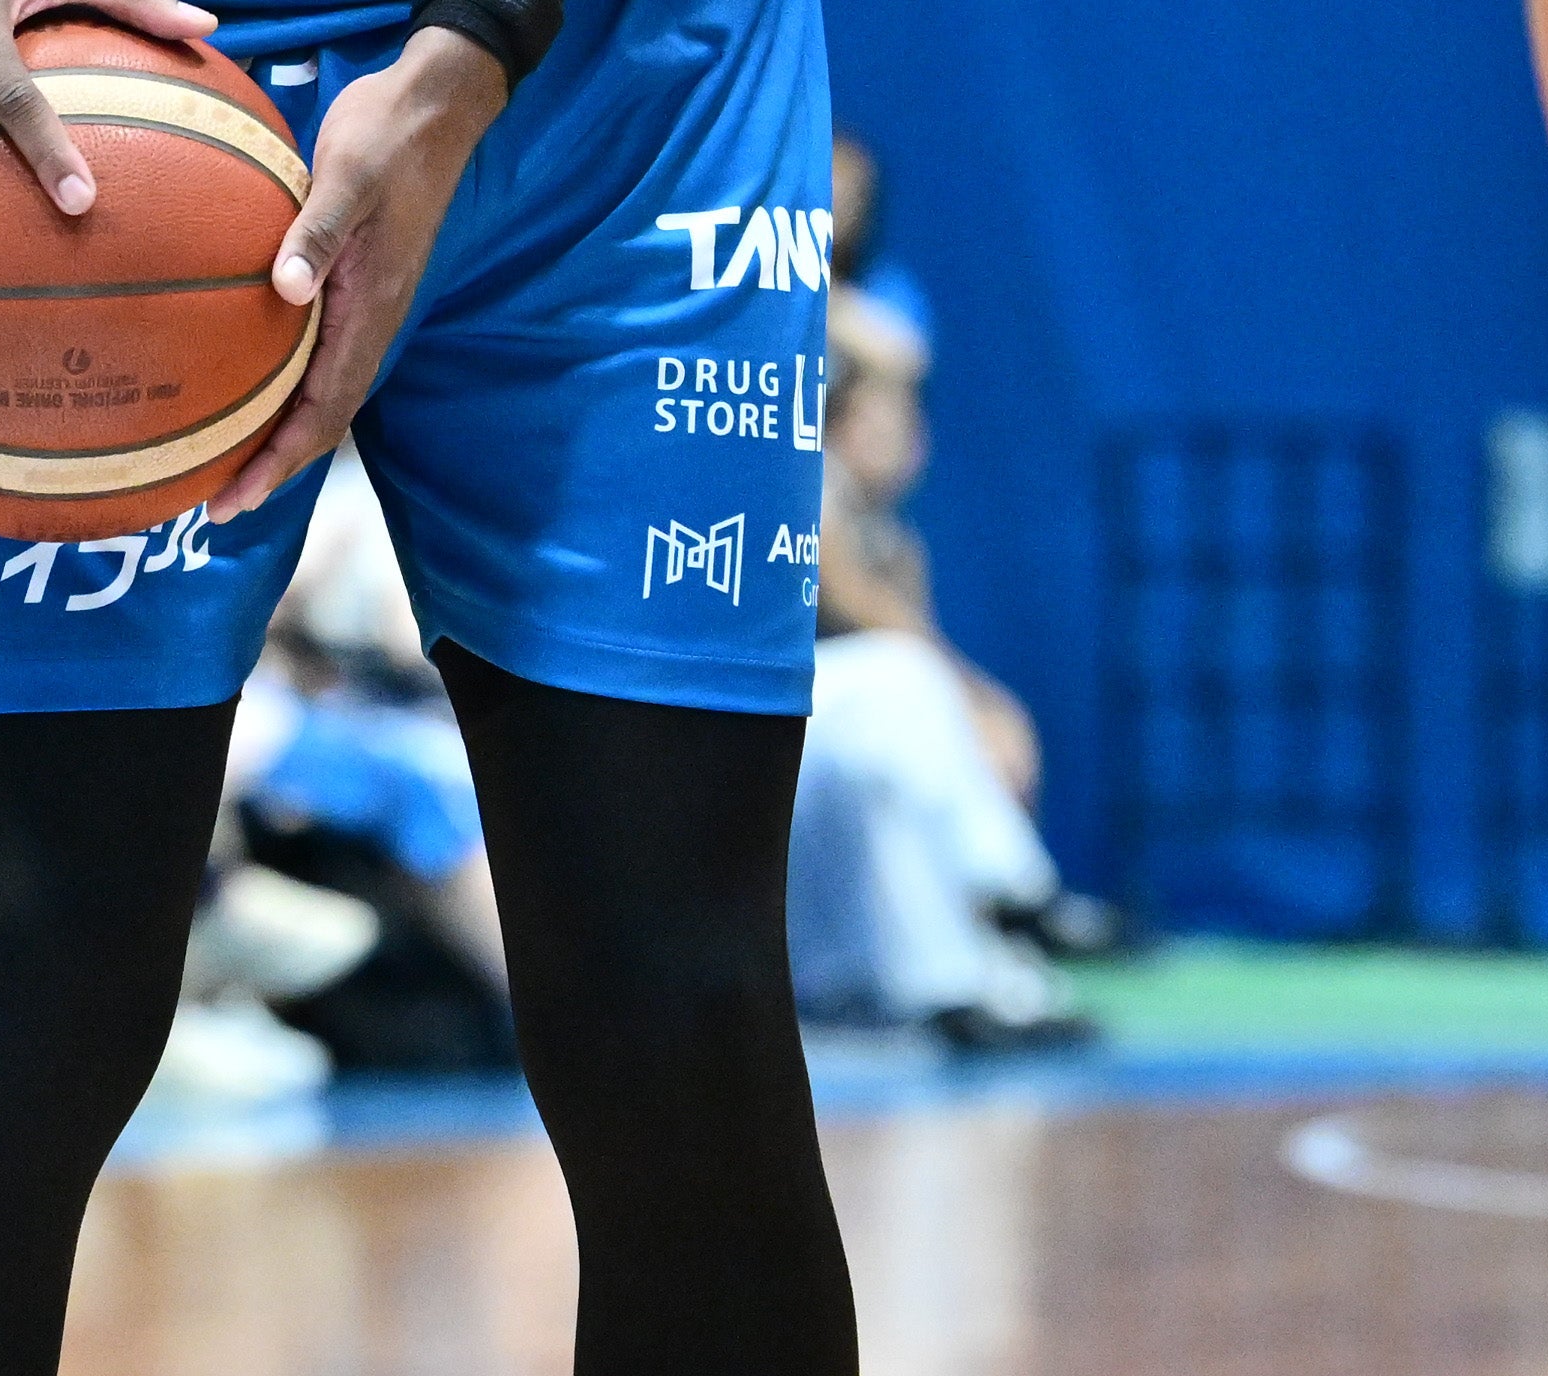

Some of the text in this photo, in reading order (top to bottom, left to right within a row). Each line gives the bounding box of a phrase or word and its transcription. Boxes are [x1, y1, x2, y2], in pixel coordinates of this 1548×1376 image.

[656, 356, 780, 397] DRUG
[653, 398, 779, 440] STORE
[793, 354, 827, 451] Li
